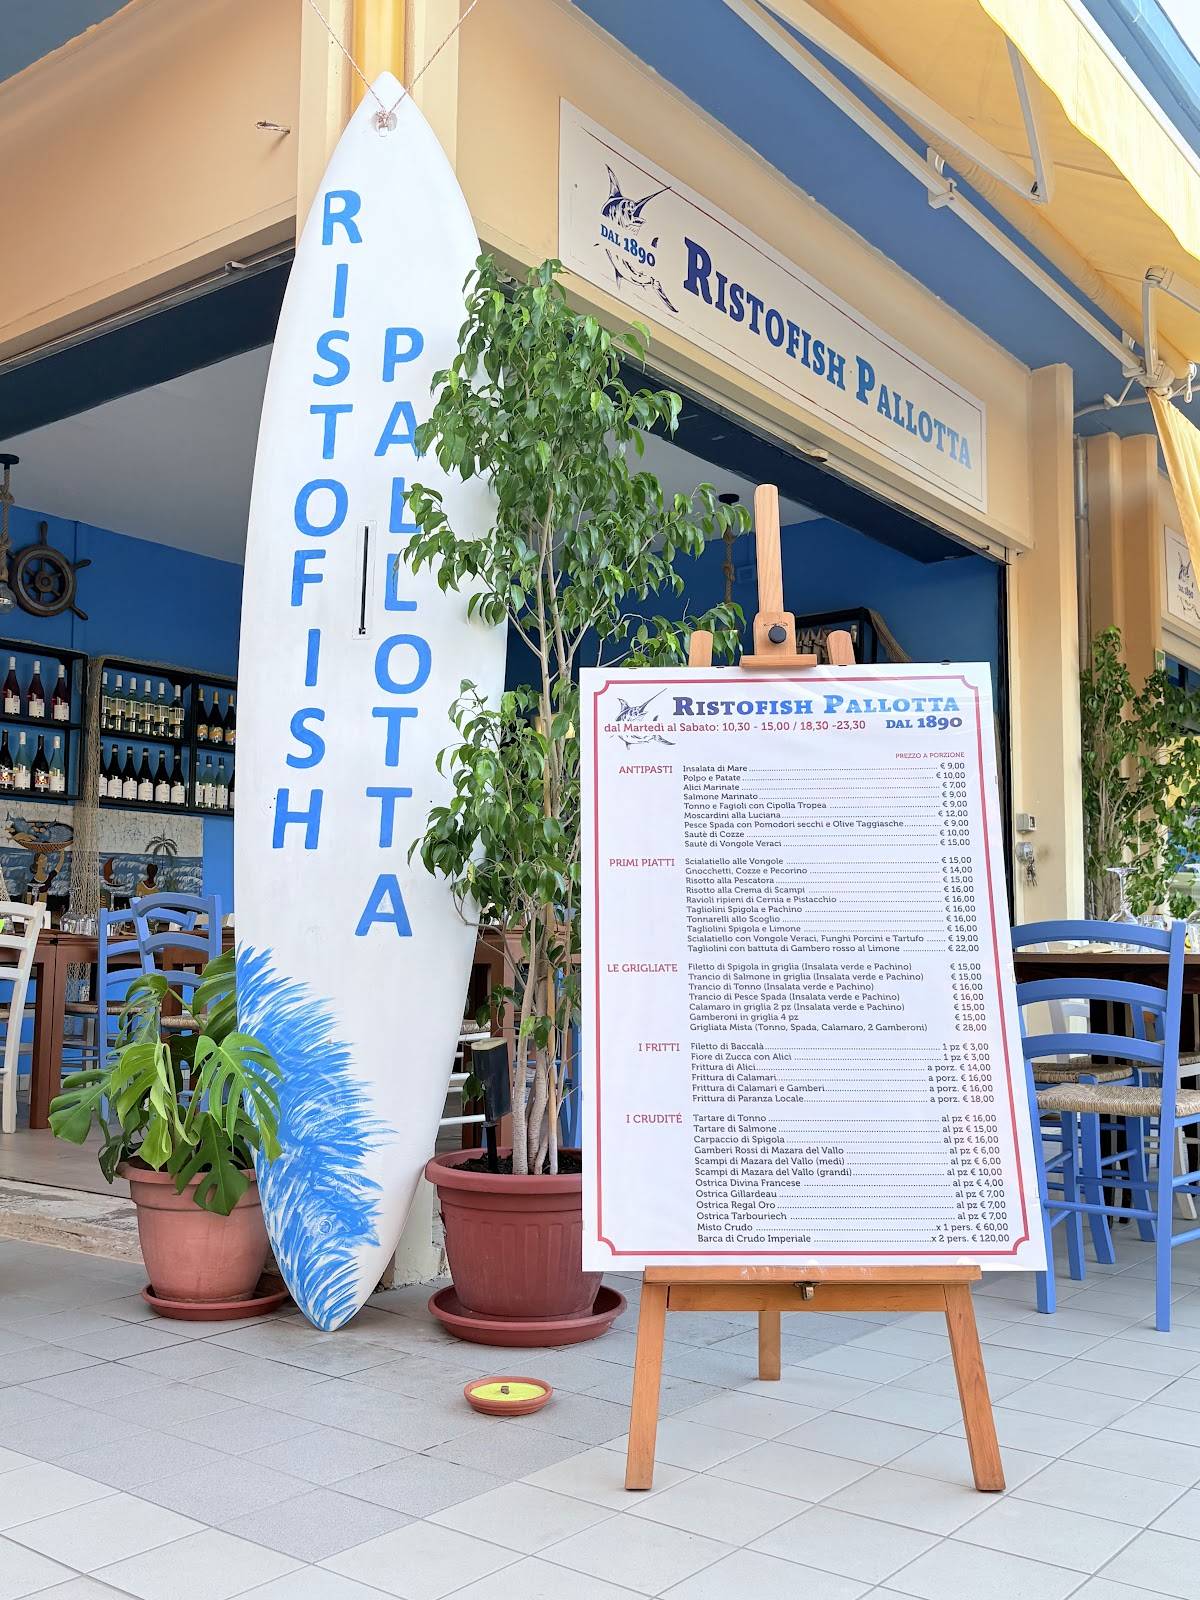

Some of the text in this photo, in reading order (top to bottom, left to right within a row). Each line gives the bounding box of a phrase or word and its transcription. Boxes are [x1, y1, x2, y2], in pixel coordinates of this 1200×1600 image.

[600, 223, 656, 267] DAL 1890
[683, 236, 972, 470] RISTOFISH PALLOTTA
[272, 189, 363, 850] RISTOFISH
[354, 327, 432, 937] PALLOTTA
[672, 694, 960, 716] RISTOFISH PALLOTTA
[604, 723, 621, 733] dal
[667, 723, 677, 732] al
[679, 722, 719, 732] Sabato:
[722, 722, 750, 732] 10,30
[761, 721, 790, 732] 15,00
[793, 722, 797, 730] /
[800, 721, 829, 732] 18,30
[885, 715, 963, 731] DAL 1890
[618, 765, 673, 774] ANTIPASTI
[942, 781, 948, 789] €
[949, 781, 966, 789] 7,00
[941, 790, 948, 798] €
[949, 790, 967, 799] 9,00
[731, 811, 747, 819] alla
[748, 811, 781, 819] Luciana
[945, 810, 968, 818] 12,00
[684, 821, 707, 829] Pesce
[709, 821, 735, 830] Spada
[797, 820, 824, 828] secchi
[832, 820, 855, 828] Olive
[855, 820, 904, 829] Taggiasche
[943, 819, 949, 827] €
[950, 819, 969, 827] 9,00
[709, 840, 718, 848] di
[719, 840, 754, 849] Vongole
[939, 838, 946, 846] €
[947, 838, 971, 846] 15,00
[609, 858, 675, 867] PRIMI PIATTI
[685, 856, 972, 866] Scialatiello alle Vongole € 15,00
[685, 867, 734, 875] Gnocchetti,
[735, 867, 761, 875] Cozze
[942, 866, 948, 874] €
[950, 866, 973, 874] 14,00
[734, 876, 775, 884] Pescatora
[942, 875, 948, 883] €
[950, 875, 974, 884] 15,00
[686, 896, 715, 904] Ravioli
[716, 897, 744, 905] ripieni
[745, 896, 754, 904] di
[793, 895, 837, 903] Pistacchio
[944, 895, 950, 903] €
[952, 895, 975, 903] 16,00
[686, 914, 977, 924] Tonnarelli allo Scoglio € 16,00
[607, 963, 678, 973] LE GRIGLIATE
[688, 963, 715, 971] Filetto
[716, 963, 726, 971] di
[727, 963, 759, 972] Spigola
[761, 963, 770, 971] in
[771, 962, 800, 972] griglia
[801, 962, 839, 971] (Insalata
[840, 963, 865, 971] verde
[874, 963, 912, 971] Pachino)
[950, 962, 956, 971] €
[958, 963, 981, 971] 15,00
[689, 1023, 987, 1033] Grigliata Mista (Tonno, Spada, Calamaro, 2 Gamberoni) € 28,00
[645, 1043, 680, 1052] FRITTI
[690, 1042, 989, 1052] Filetto di Baccalà 1 pz € 3,00
[692, 1094, 725, 1102] Frittura
[727, 1094, 736, 1102] di
[737, 1094, 773, 1103] Paranza
[774, 1095, 804, 1103] Locale
[937, 1096, 960, 1105] porz.
[962, 1095, 969, 1103] €
[970, 1095, 995, 1103] 18,00
[693, 1135, 999, 1145] Carpaccio di Spigola al pz € 16,00
[695, 1189, 1005, 1200] Ostrica Gillardeau al pz € 7,00
[696, 1211, 1007, 1222] Ostrica Tarbouriech al pz € 7,00
[697, 1223, 722, 1231] Misto
[724, 1223, 753, 1232] Crudo
[943, 1223, 949, 1231] 1
[951, 1225, 973, 1233] pers.
[975, 1223, 982, 1231] €
[983, 1223, 1009, 1232] 60,00
